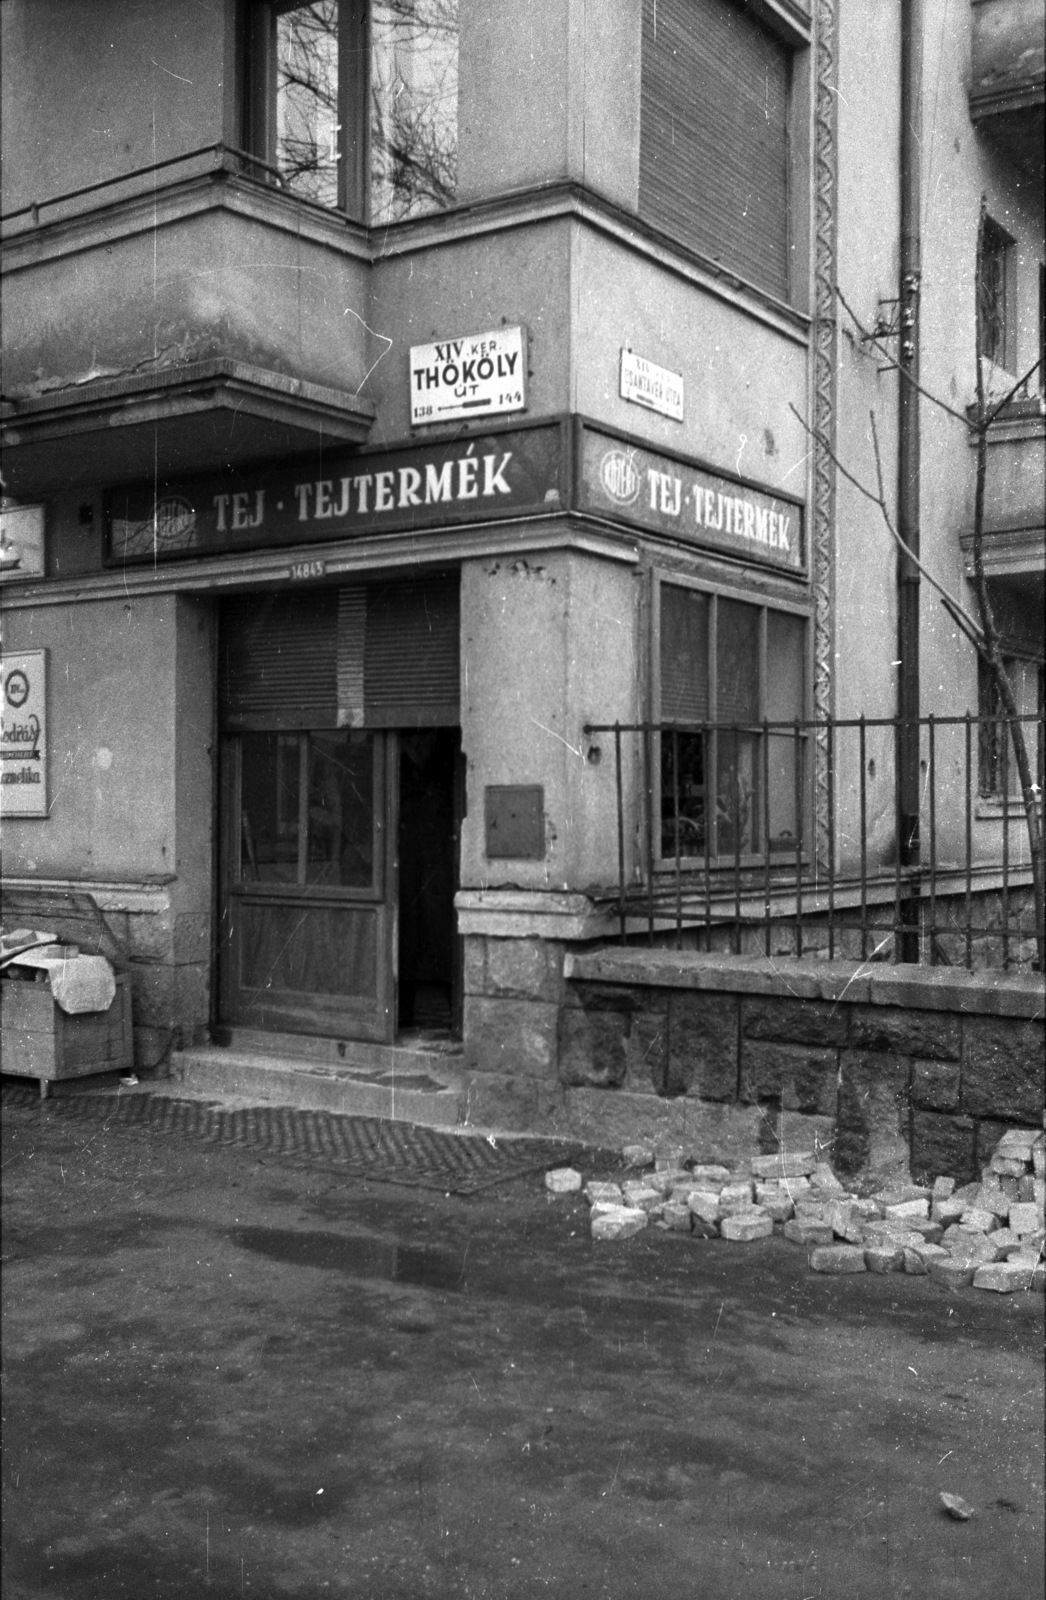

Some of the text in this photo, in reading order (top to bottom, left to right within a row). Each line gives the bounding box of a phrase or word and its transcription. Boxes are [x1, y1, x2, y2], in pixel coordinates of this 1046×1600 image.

[471, 340, 502, 355] KER.
[413, 351, 518, 391] THÖKÖLY
[413, 405, 433, 418] 138
[213, 442, 513, 531] TEJ TEJTERMÉK
[647, 469, 790, 551] TEJ TEJTERMÉK
[291, 559, 325, 579] 14843
